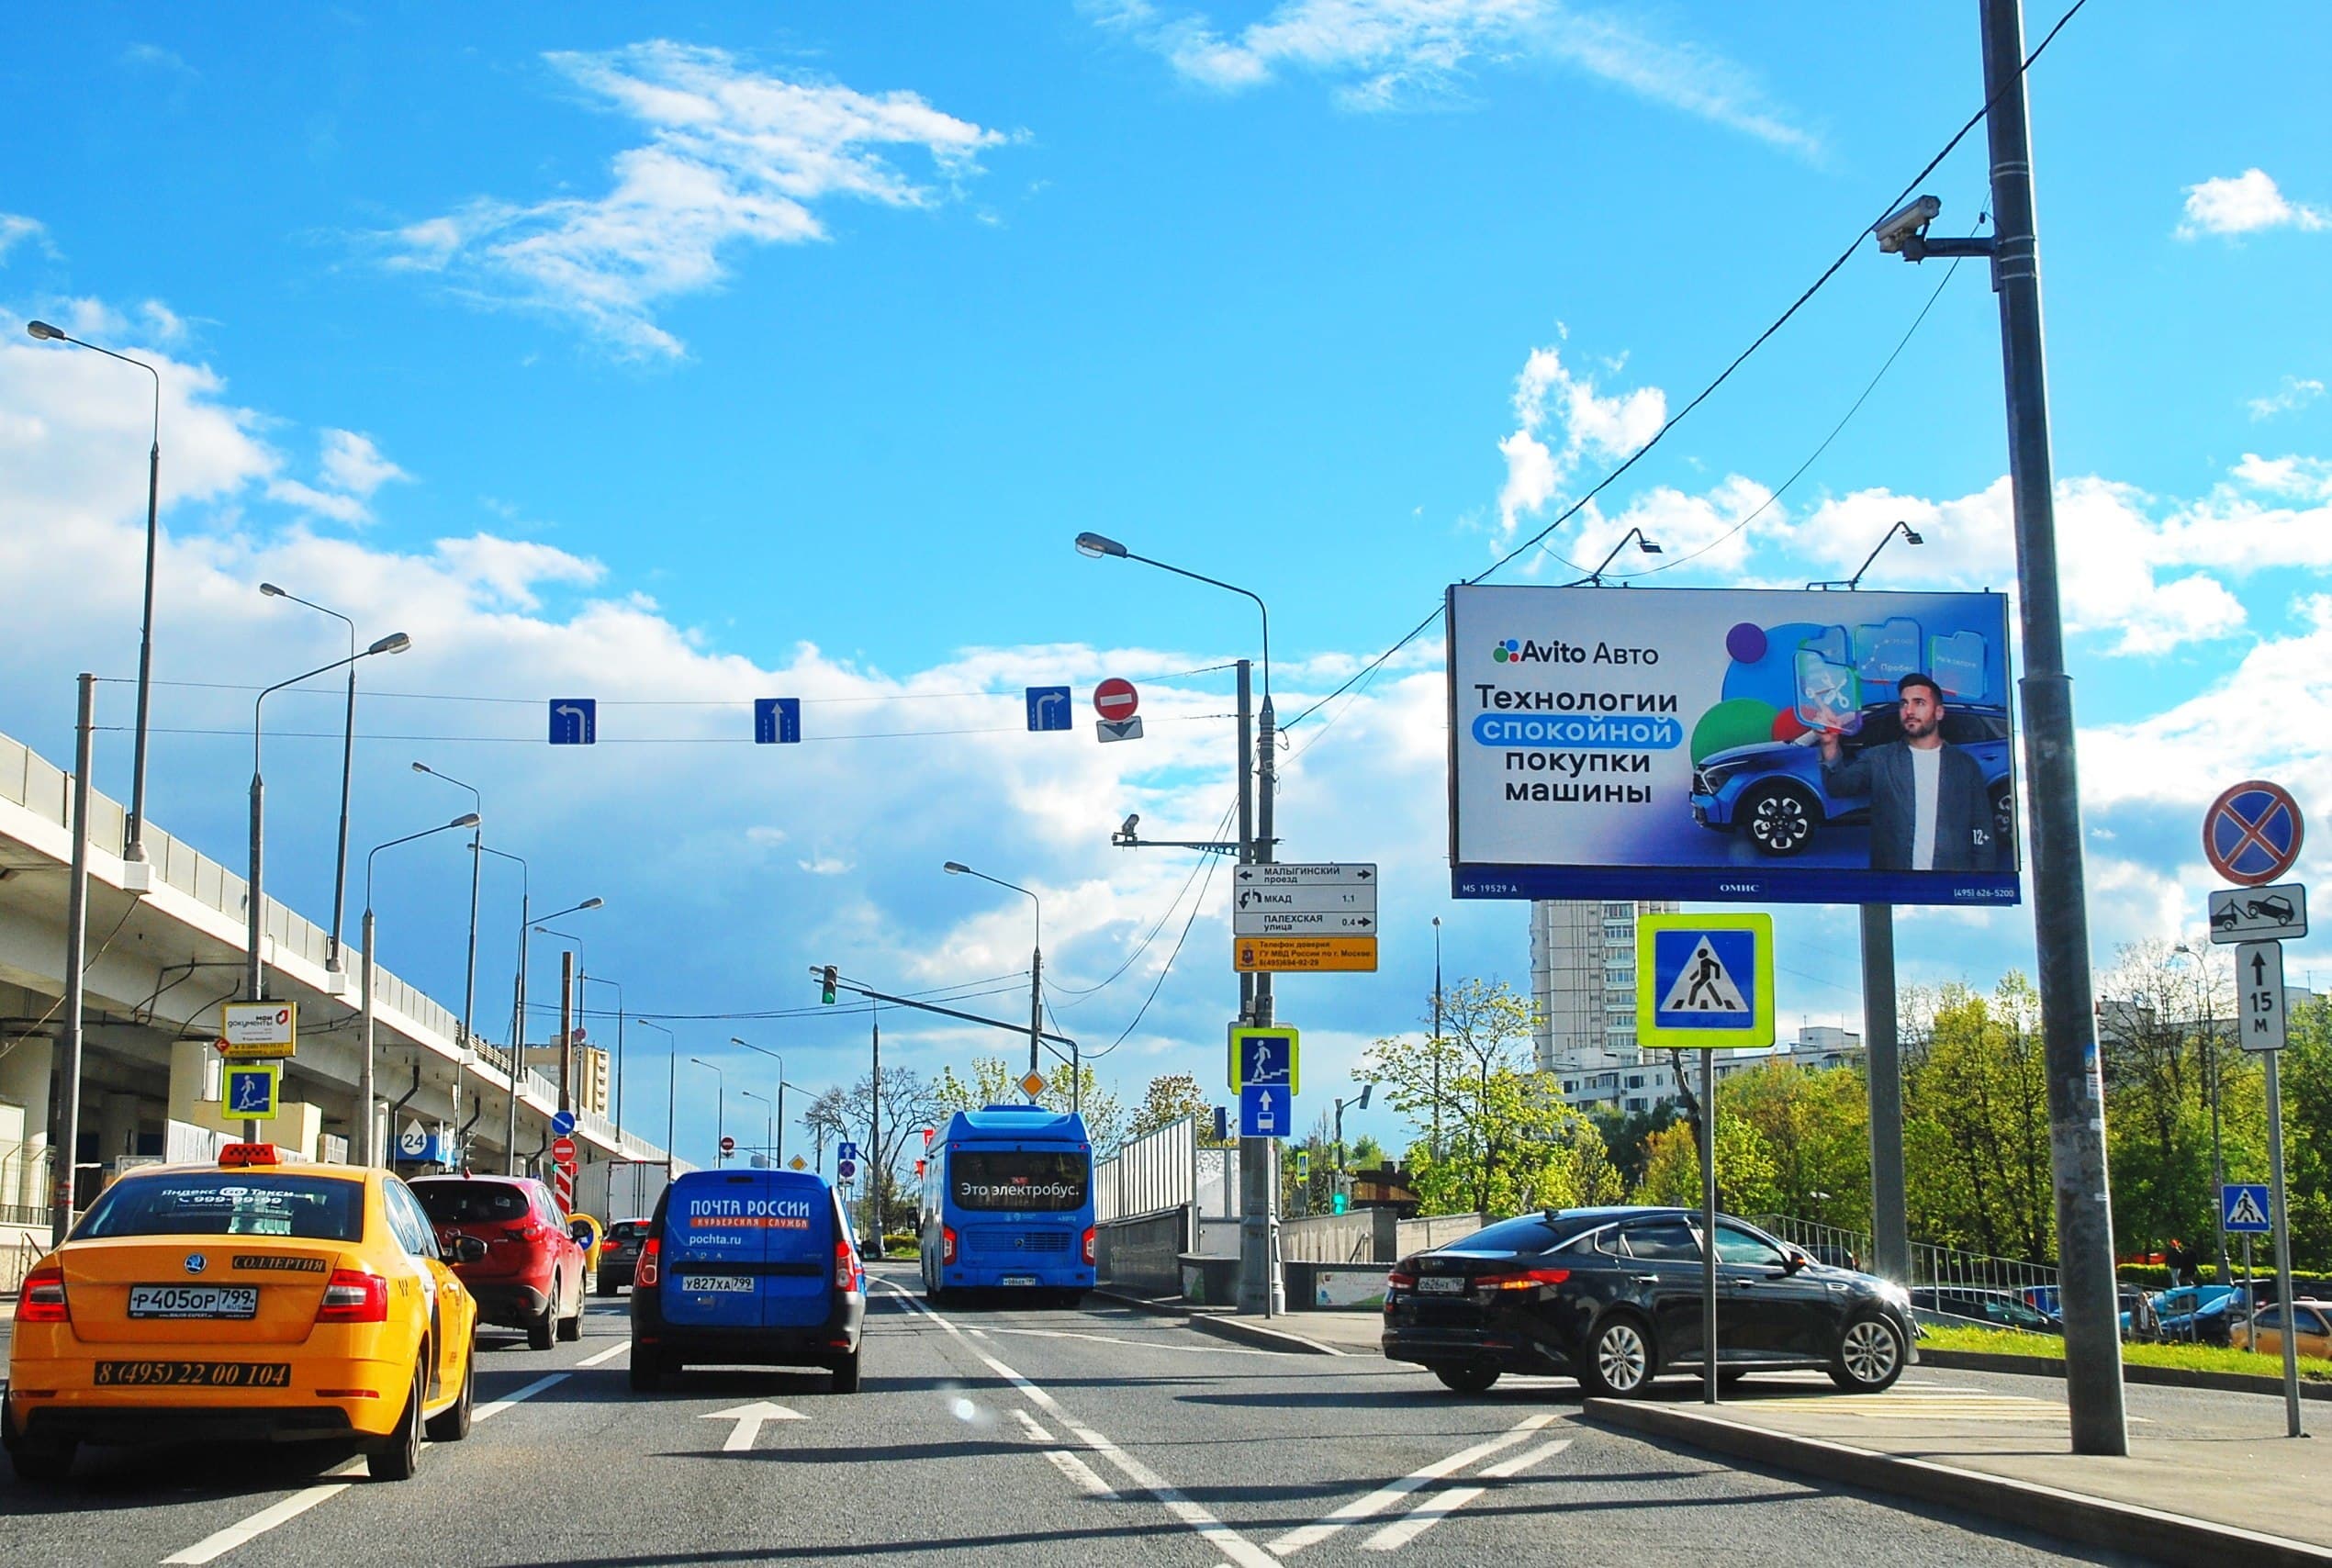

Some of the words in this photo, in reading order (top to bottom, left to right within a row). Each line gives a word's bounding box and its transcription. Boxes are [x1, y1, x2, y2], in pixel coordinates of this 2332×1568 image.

[1520, 640, 1586, 664] Avito
[1593, 642, 1659, 666] Авто
[1474, 684, 1677, 712] Технологии
[1483, 715, 1672, 743] спокойной
[1506, 752, 1650, 778] покупки
[1506, 783, 1652, 803] машины
[1973, 829, 1990, 845] 12+
[1264, 867, 1340, 875] МАЛЫГИНСКИЙ
[1463, 884, 1476, 892] MS
[1480, 884, 1507, 892] 19529
[1954, 889, 1975, 897] (495)
[1976, 889, 2014, 897] 626-5200
[1264, 895, 1293, 904] МКАД
[2250, 991, 2272, 1013] 15
[405, 1134, 424, 1148] 24
[962, 1182, 988, 1195] Это
[992, 1182, 1079, 1197] электробус.
[194, 1196, 282, 1204] 999-99-99
[690, 1200, 741, 1215] ПОЧТА
[747, 1201, 810, 1216] РОССИИ
[768, 1219, 808, 1227] СЛУЖБА
[690, 1234, 742, 1246] pochta.ru
[734, 1278, 751, 1287] 799
[221, 1290, 251, 1304] 799
[98, 1363, 112, 1383] 8
[118, 1363, 173, 1383] (495)
[177, 1363, 206, 1383] 22
[212, 1364, 240, 1384] 00
[247, 1365, 286, 1385] 104
